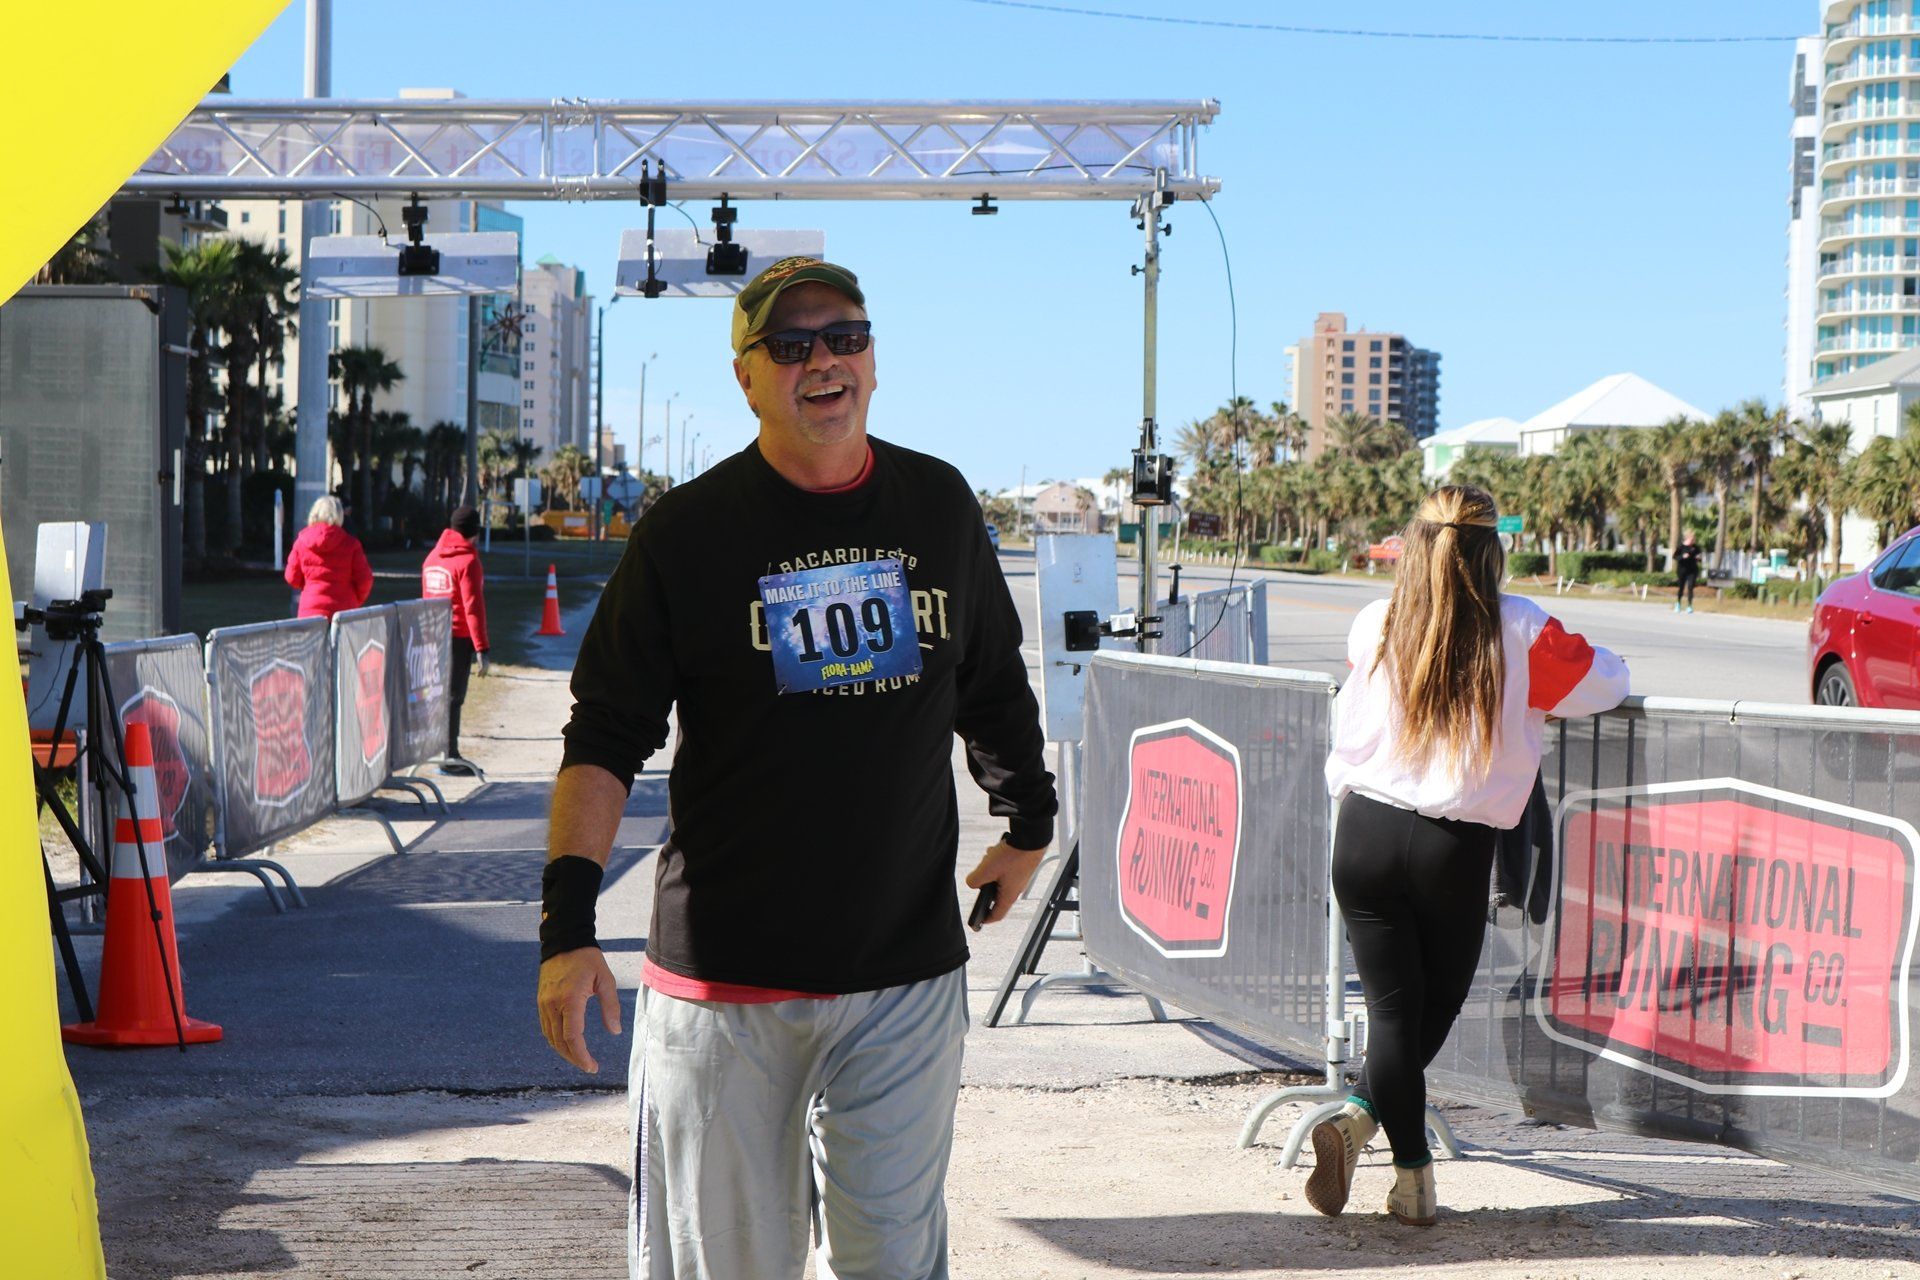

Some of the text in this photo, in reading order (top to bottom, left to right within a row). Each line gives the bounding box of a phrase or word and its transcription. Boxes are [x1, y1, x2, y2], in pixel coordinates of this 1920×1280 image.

[764, 572, 902, 605] MAKE IT TO THE LINE
[779, 547, 867, 575] BACARDI
[792, 597, 895, 664] 109
[821, 659, 875, 680] FLORA-BAMA
[1140, 767, 1223, 838] INTERNATIONAL
[1129, 826, 1200, 912] RUNNING
[1596, 840, 1862, 939] INTERNATIONAL
[1590, 918, 1847, 1036] RUNNING CO.
